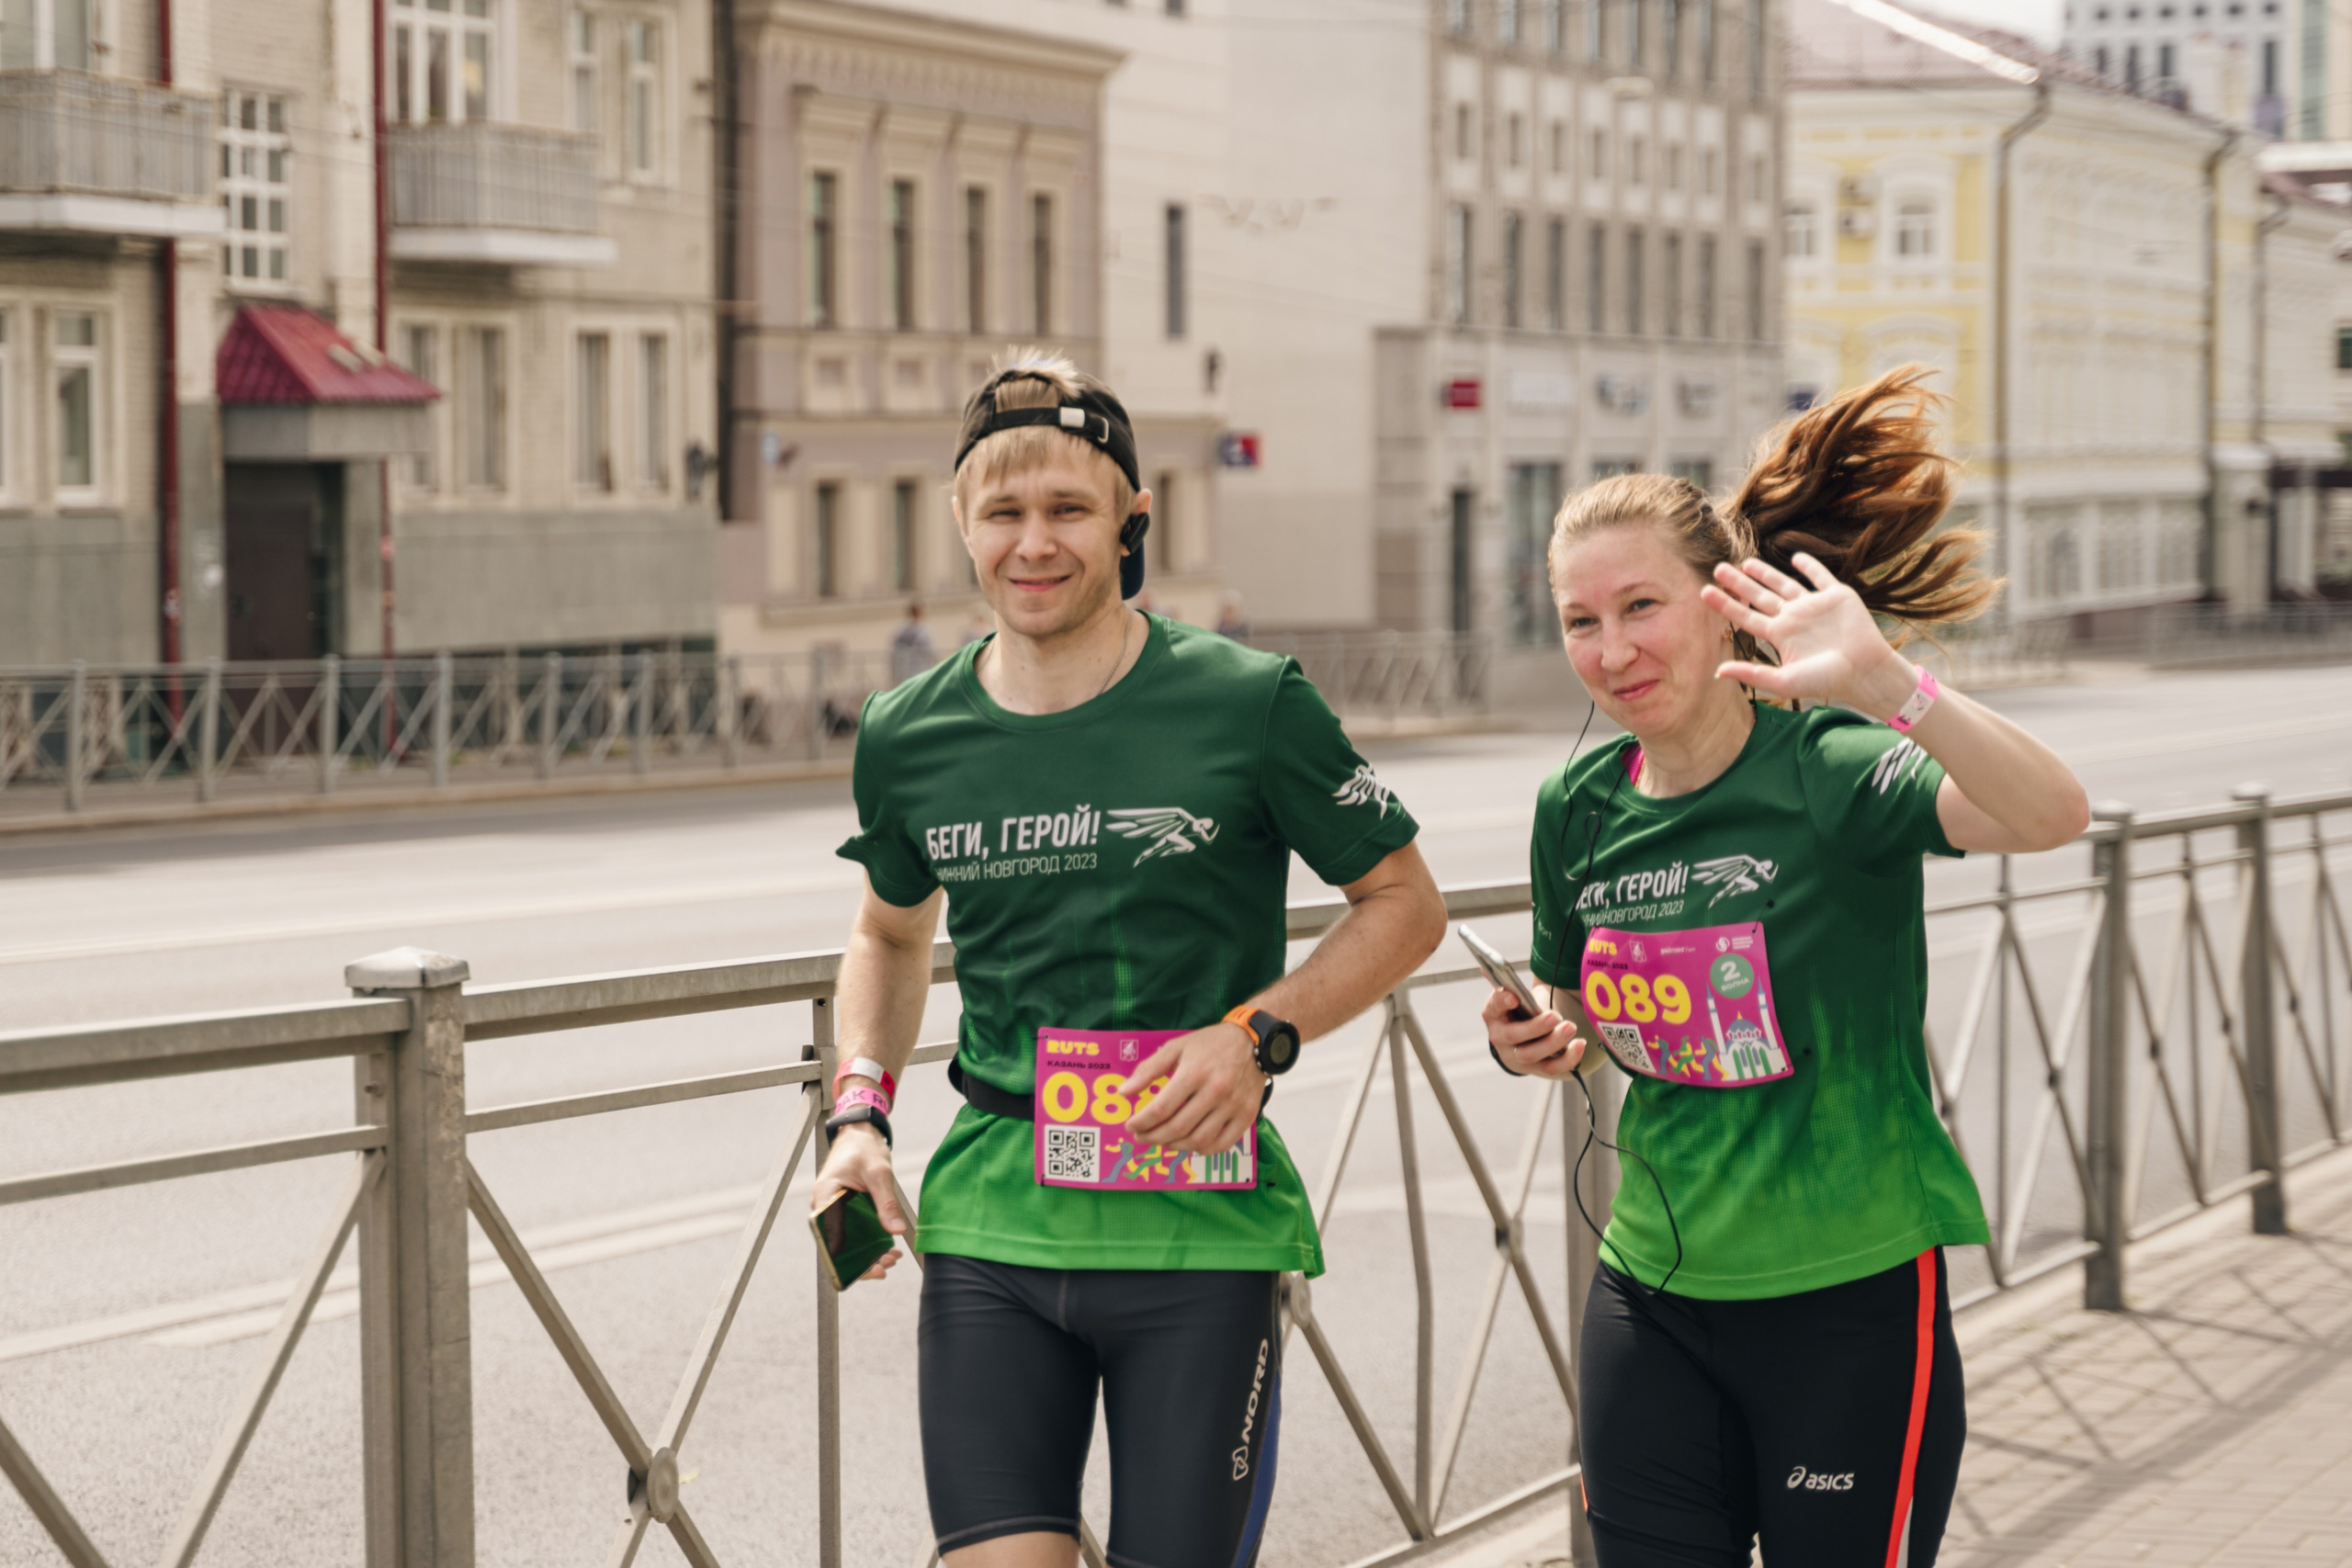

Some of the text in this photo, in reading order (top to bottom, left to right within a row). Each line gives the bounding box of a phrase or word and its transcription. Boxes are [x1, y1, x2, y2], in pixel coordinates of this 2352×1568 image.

[926, 804, 1101, 862] БЕГИ, ГЕРОЙ!
[984, 854, 1060, 879] НОВГОРОД
[1064, 852, 1098, 872] 2023
[1616, 861, 1689, 904] ГЕРОЙ!
[1604, 904, 1657, 924] НОВГОРОД
[1658, 899, 1685, 917] 2023
[1720, 961, 1741, 982] 2
[1721, 977, 1750, 992] ВОЛНА
[1586, 971, 1691, 1024] 089
[1046, 1040, 1100, 1055] RUTS
[1047, 1060, 1086, 1069] КАЗАНЬ
[1241, 1338, 1269, 1445] NORD
